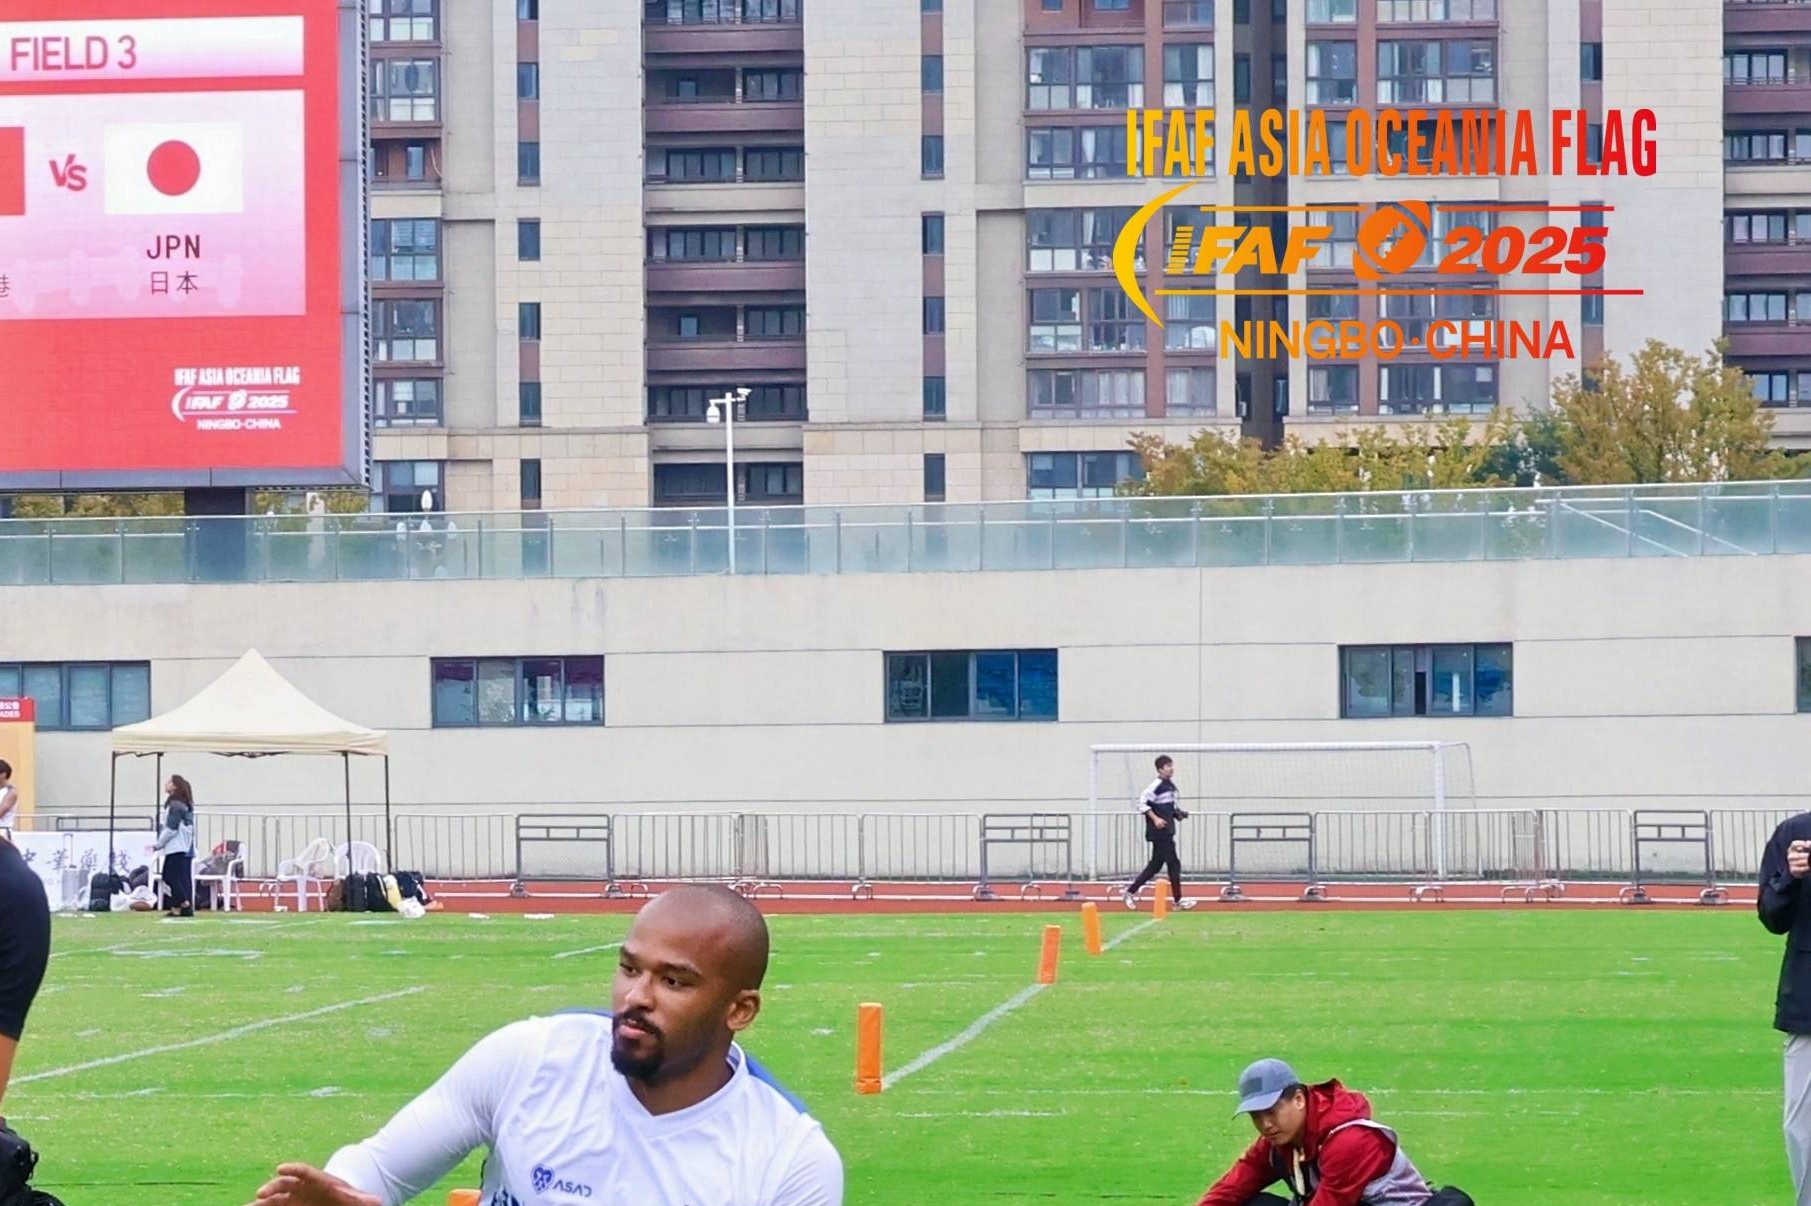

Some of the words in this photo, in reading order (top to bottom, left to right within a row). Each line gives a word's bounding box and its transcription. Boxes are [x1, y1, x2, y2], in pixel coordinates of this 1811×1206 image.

[10, 36, 109, 71] FIELD
[117, 34, 137, 70] 3
[146, 234, 201, 260] JPN
[150, 270, 199, 296] 日本
